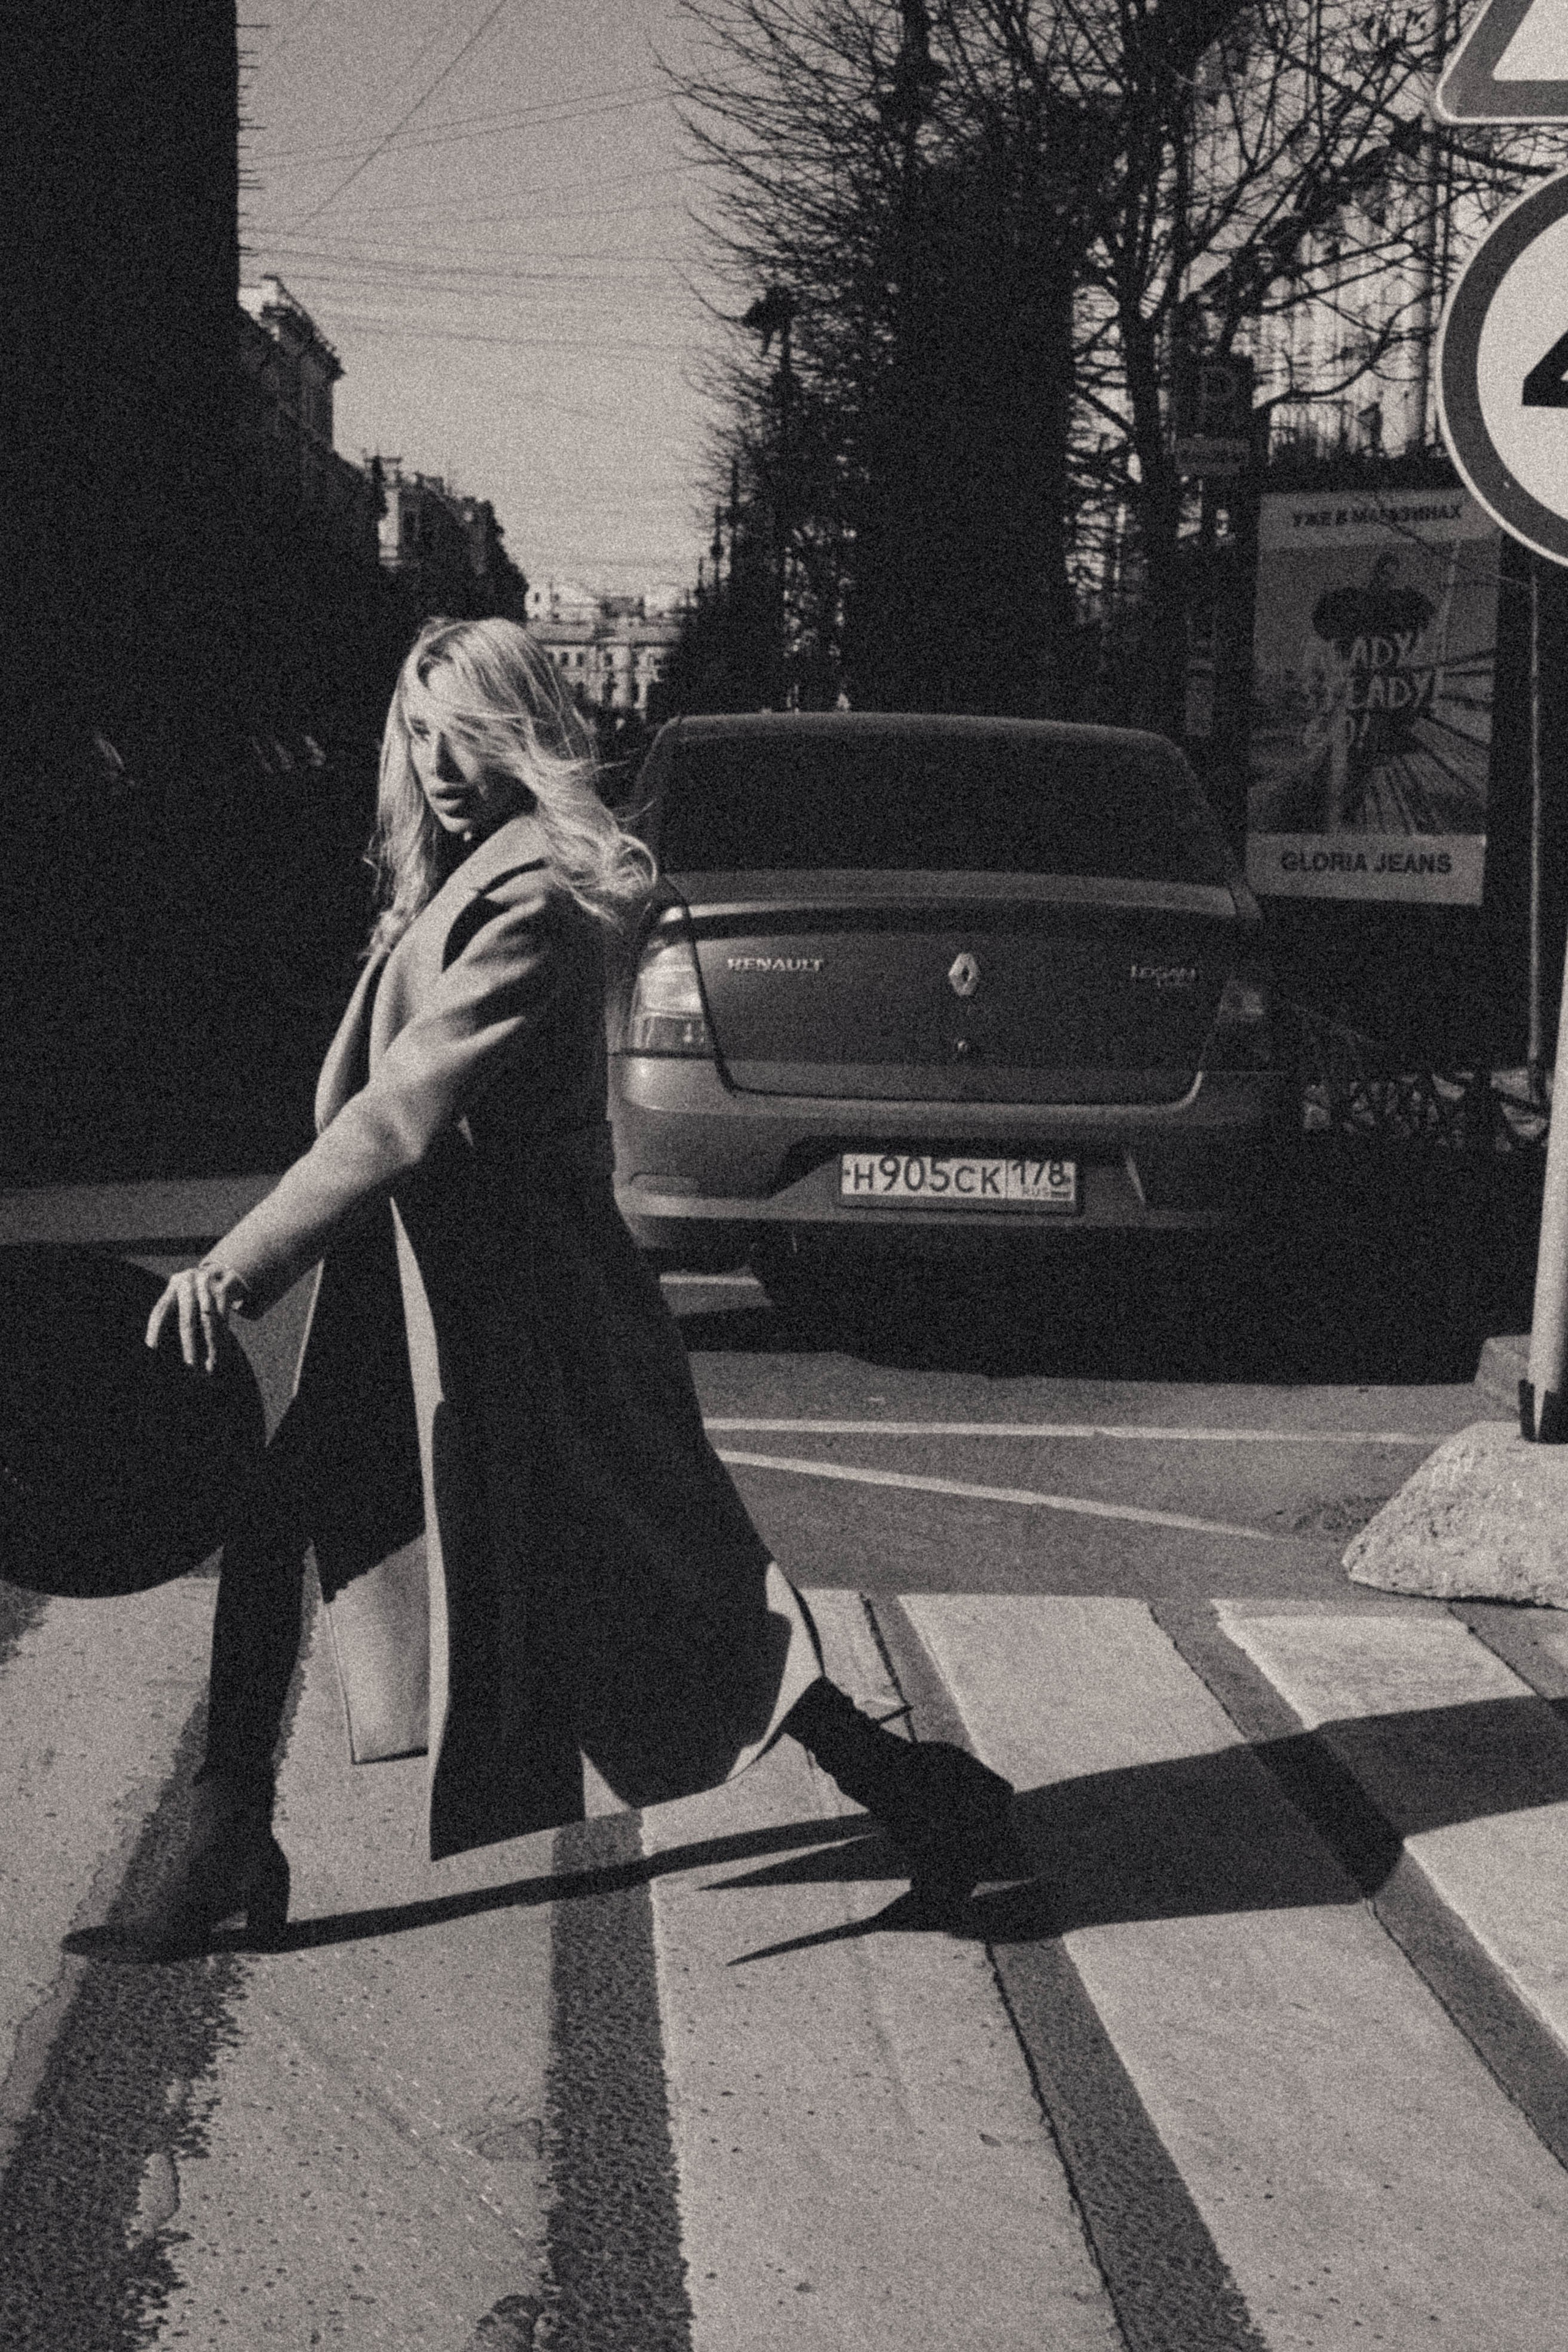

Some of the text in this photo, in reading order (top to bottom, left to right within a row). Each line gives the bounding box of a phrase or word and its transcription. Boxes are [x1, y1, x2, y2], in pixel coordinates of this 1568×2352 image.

[1280, 851, 1452, 875] GLORIA JEANS
[727, 957, 825, 973] RENAULT
[1012, 1161, 1064, 1187] 178
